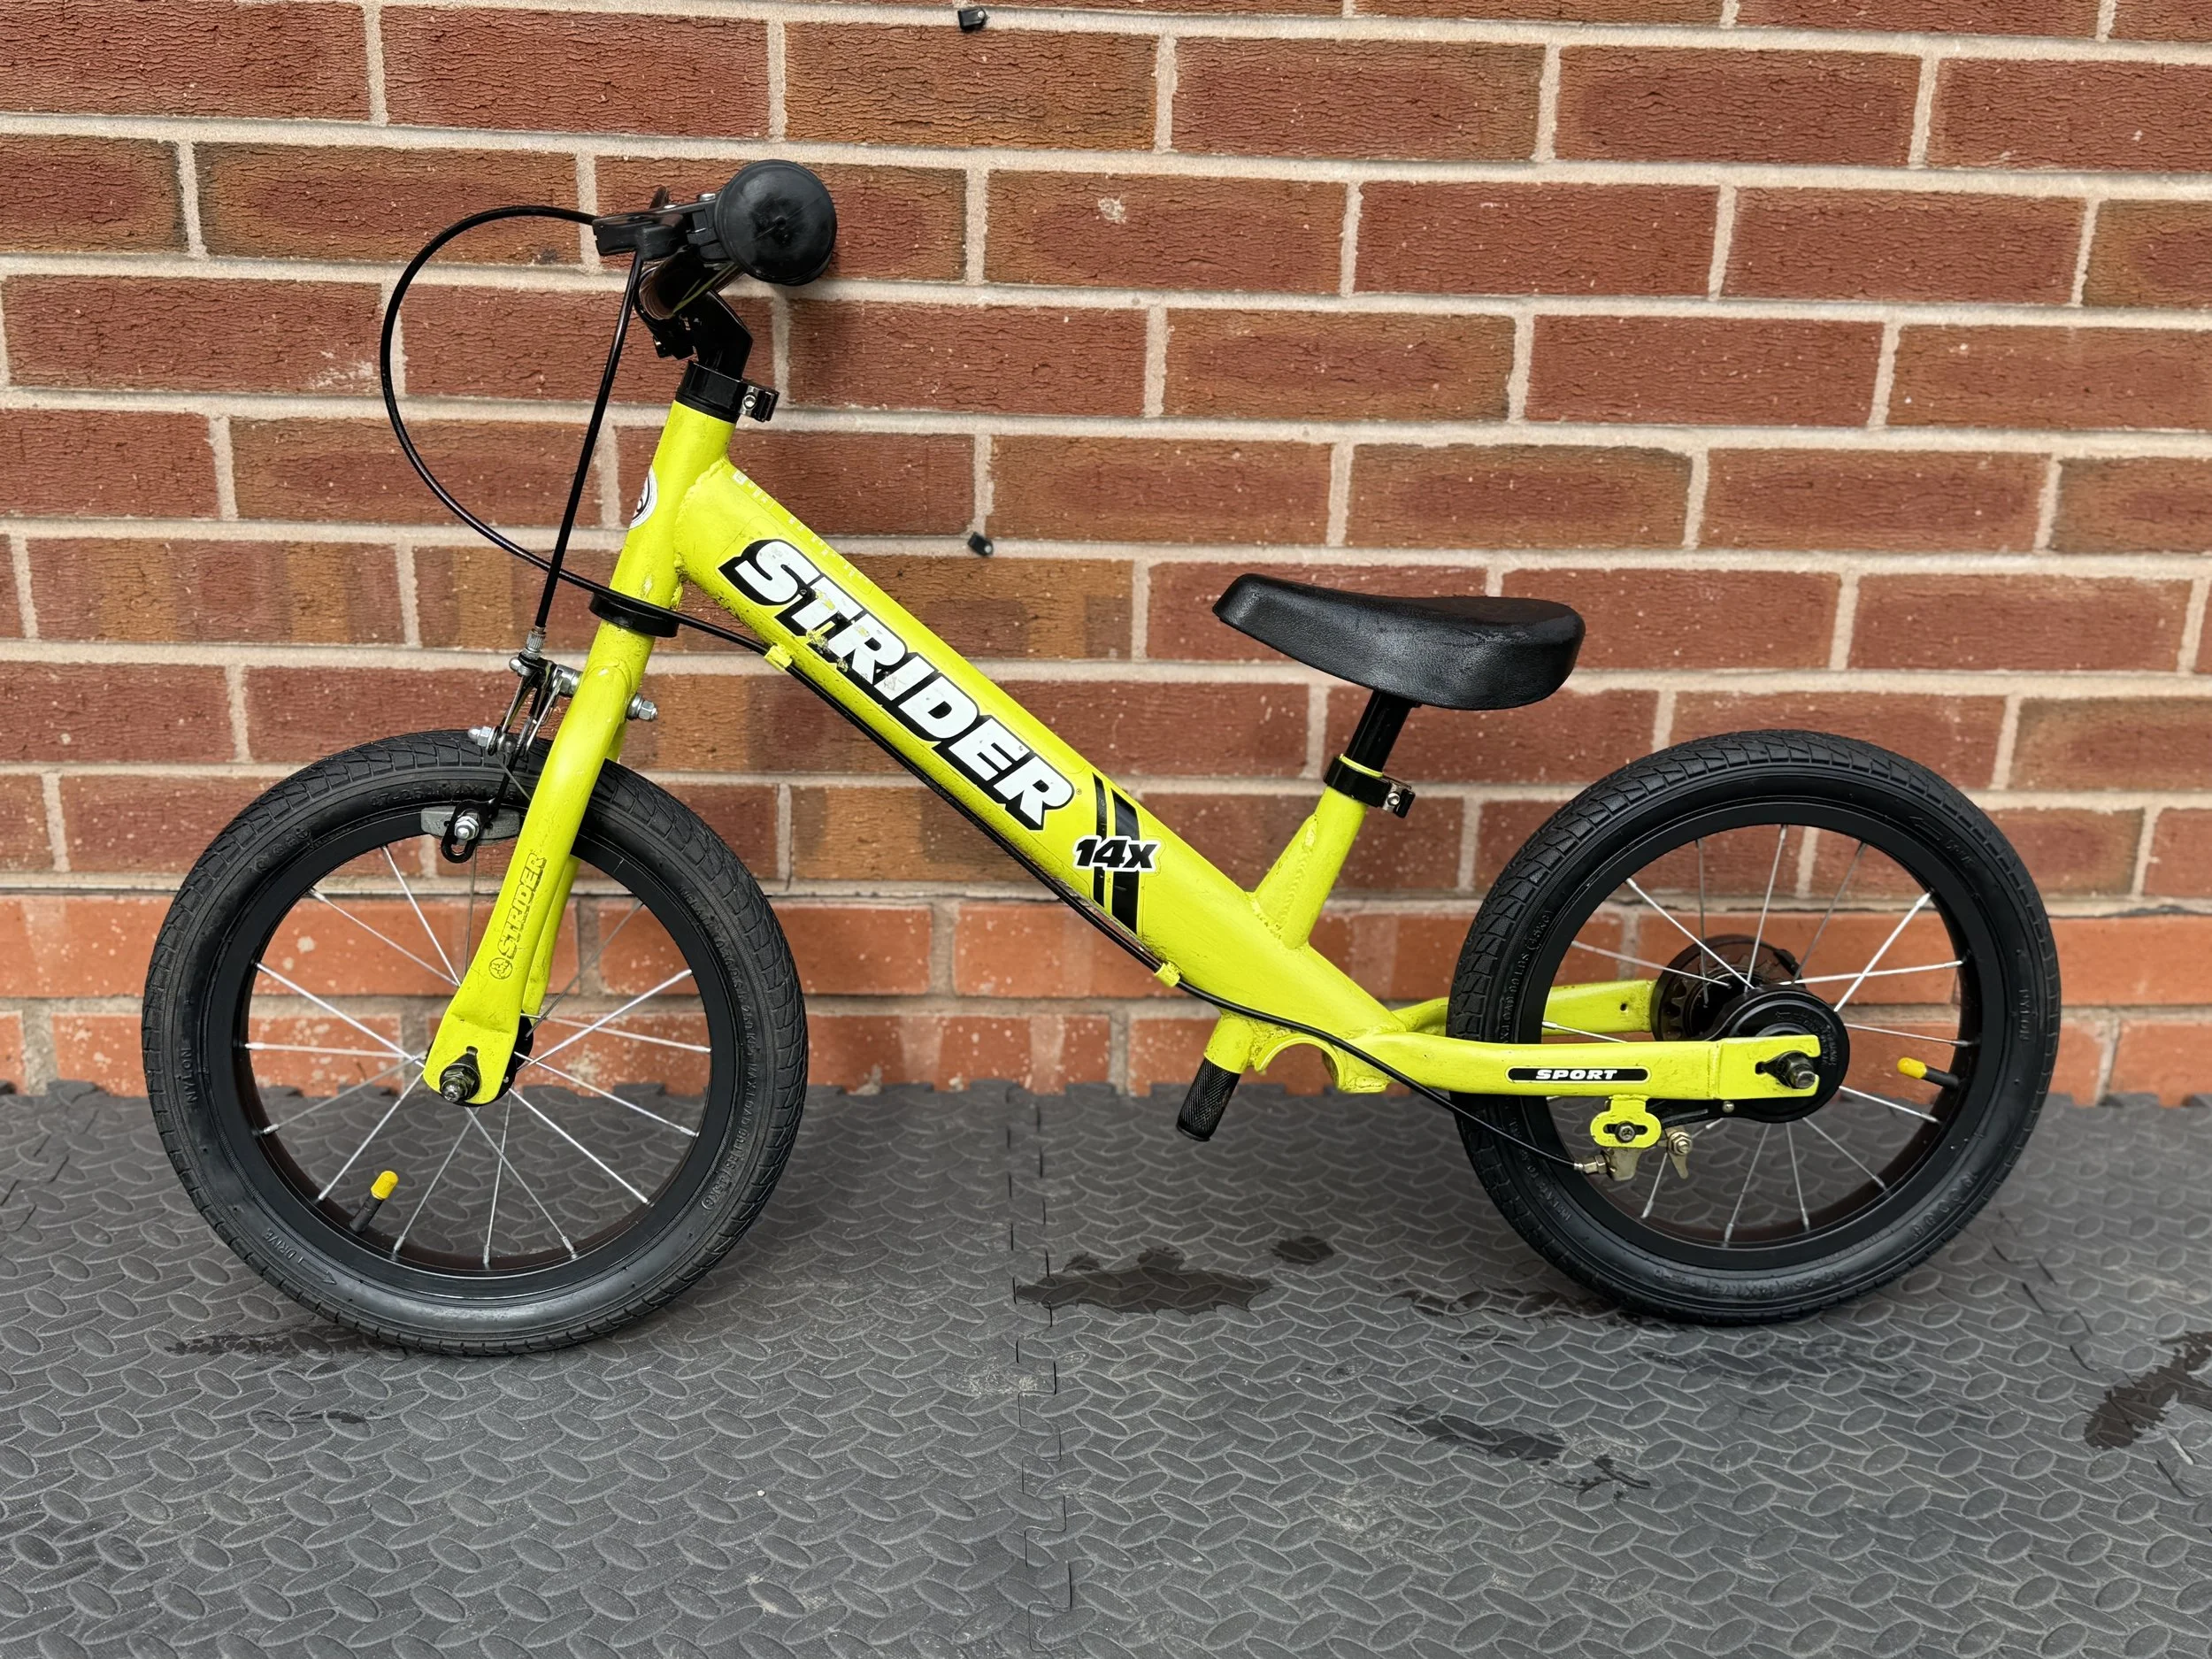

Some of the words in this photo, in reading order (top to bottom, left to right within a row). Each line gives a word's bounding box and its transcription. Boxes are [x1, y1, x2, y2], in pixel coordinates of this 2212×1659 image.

[718, 539, 1075, 831] STRIDER
[497, 852, 547, 960] STRIDER
[180, 1047, 199, 1104] NYLON
[1535, 1069, 1618, 1080] SPORT
[259, 1226, 298, 1261] DRIVE
